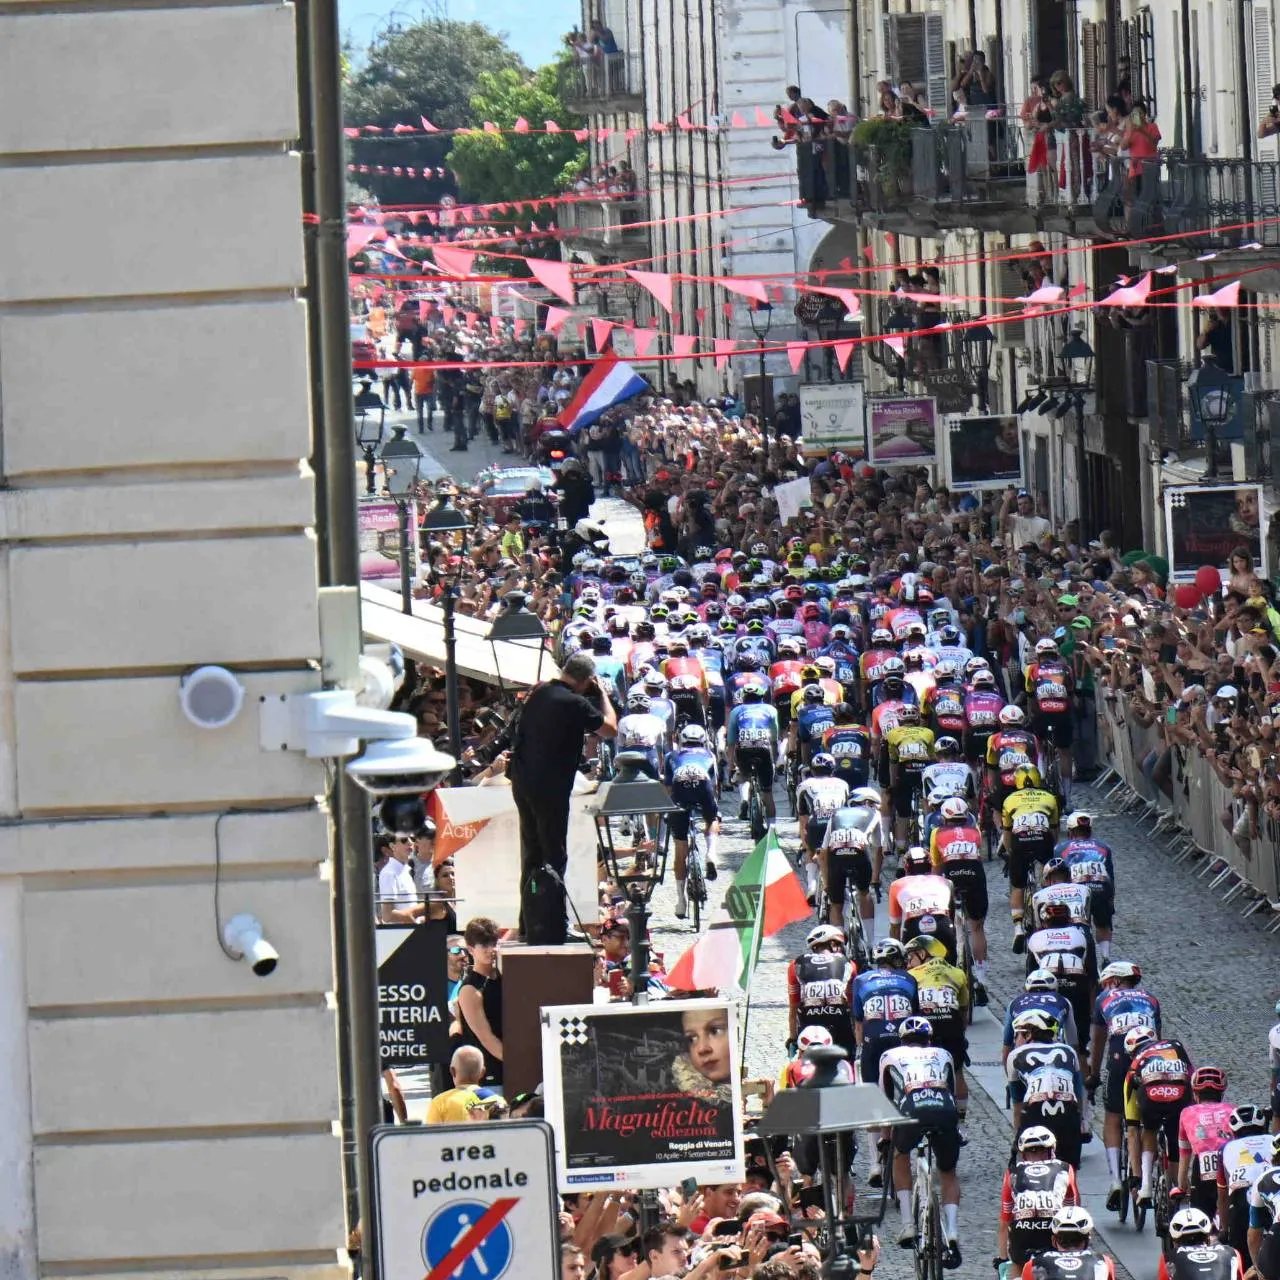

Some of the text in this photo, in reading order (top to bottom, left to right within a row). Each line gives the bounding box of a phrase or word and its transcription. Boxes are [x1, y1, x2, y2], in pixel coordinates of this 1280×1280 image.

[378, 985, 426, 1001] ESSO
[378, 1006, 442, 1023] TTERIA
[806, 1005, 843, 1017] ARKEA
[379, 1030, 415, 1042] ANCE
[380, 1044, 427, 1057] OFFICE
[912, 1090, 944, 1101] BORA
[1147, 1085, 1180, 1098] caps
[583, 1101, 718, 1138] Magnifiche
[441, 1144, 496, 1161] area
[412, 1168, 528, 1198] pedonale
[1015, 1220, 1053, 1231] ARKEA
